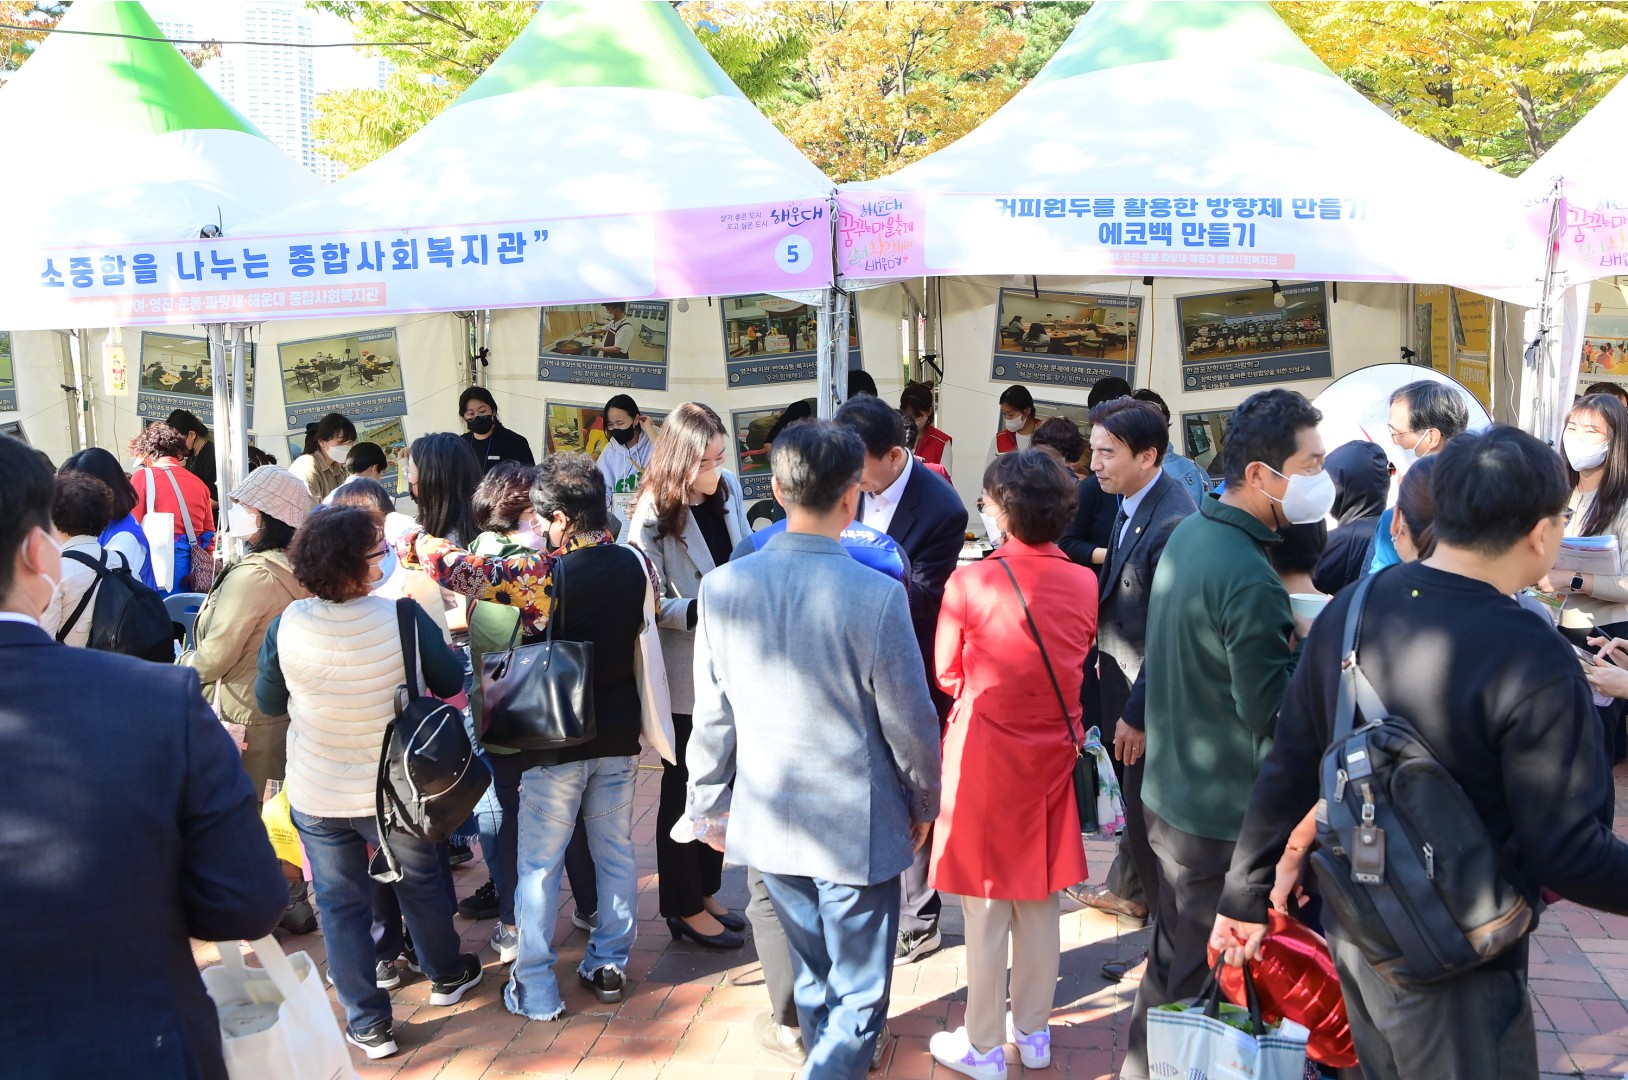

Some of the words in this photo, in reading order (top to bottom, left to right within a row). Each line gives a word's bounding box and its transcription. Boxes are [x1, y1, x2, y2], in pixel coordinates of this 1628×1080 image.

[720, 213, 733, 223] 살기
[735, 212, 747, 222] 좋은
[749, 211, 762, 220] 도시
[770, 203, 823, 228] 해운대
[860, 198, 903, 217] 해운대
[994, 198, 1116, 218] 커피원두를
[1123, 198, 1199, 218] 활용한
[1206, 198, 1283, 218] 방향제
[741, 222, 753, 231] 싶은
[755, 220, 768, 228] 도시
[1098, 222, 1172, 247] 에코백
[1181, 222, 1256, 248] 만들기
[787, 244, 799, 263] 5
[40, 253, 158, 289] 소중함을
[176, 248, 269, 281] 나누는
[289, 287, 380, 306] 종합사회복지관
[1050, 364, 1070, 373] 문제에
[1071, 366, 1084, 374] 대해
[1068, 375, 1081, 383] 위한
